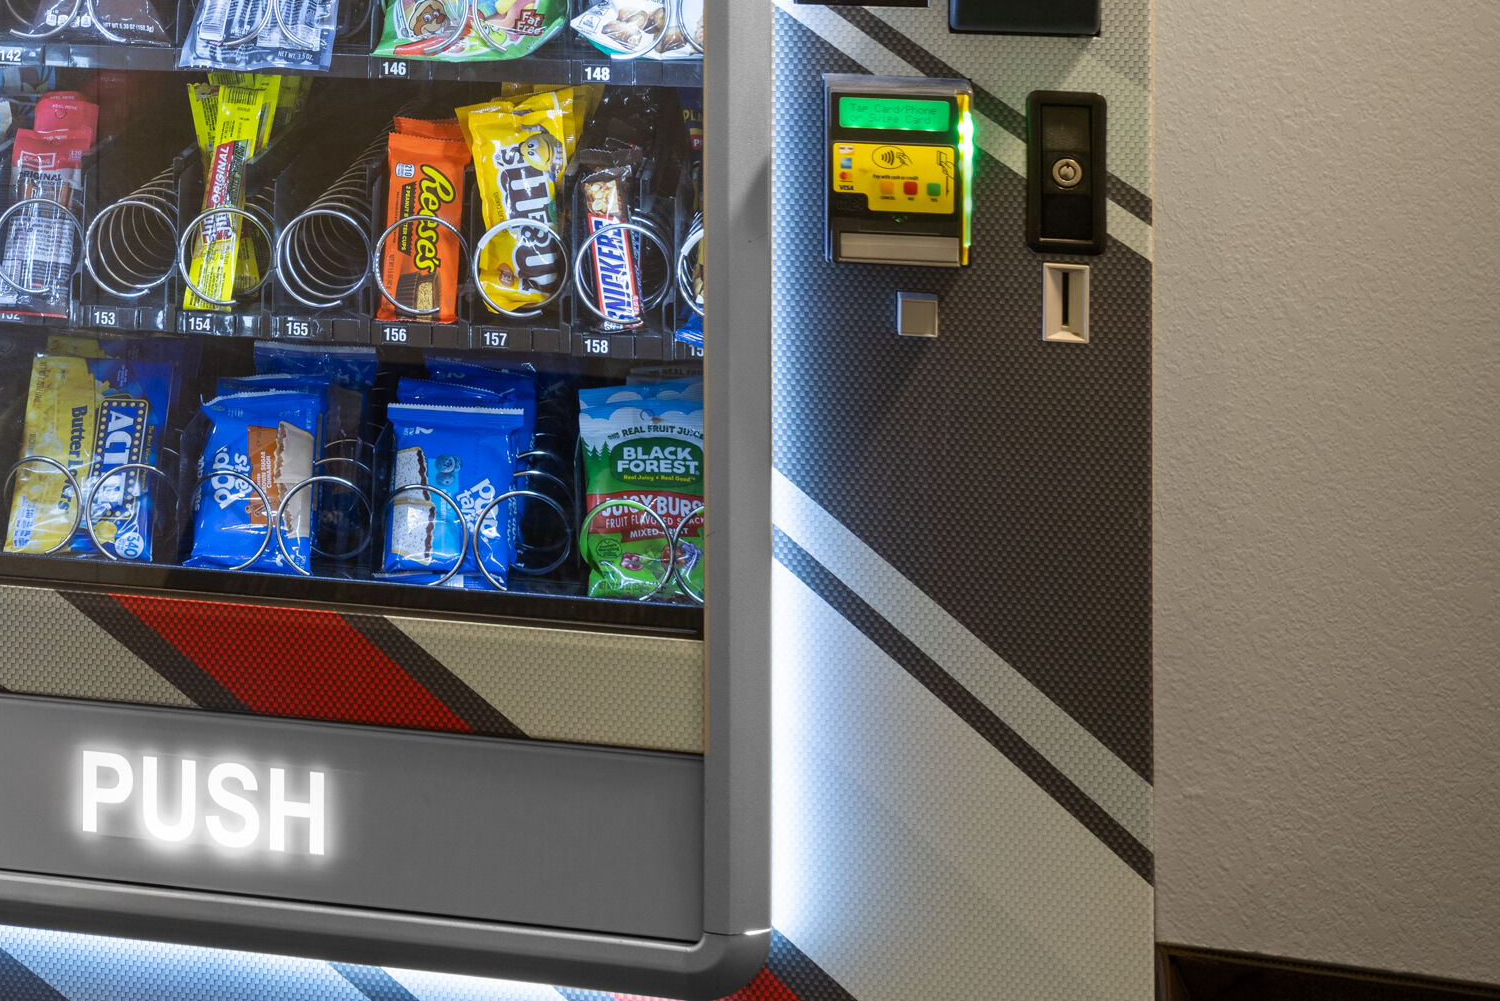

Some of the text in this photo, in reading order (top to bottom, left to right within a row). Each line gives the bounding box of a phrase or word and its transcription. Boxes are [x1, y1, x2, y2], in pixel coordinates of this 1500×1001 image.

[521, 12, 540, 26] Fat
[516, 22, 542, 34] Free
[0, 49, 21, 61] 142
[382, 62, 407, 76] 146
[585, 68, 610, 81] 148
[851, 103, 869, 113] Tap
[906, 115, 931, 125] Card
[212, 145, 230, 203] ORIGINAL
[404, 165, 413, 178] 210
[404, 190, 412, 214] PEANUT
[415, 164, 455, 273] Reese's
[94, 312, 116, 326] 153
[188, 318, 211, 331] 154
[286, 322, 308, 335] 155
[384, 328, 407, 342] 156
[484, 332, 507, 346] 157
[584, 340, 609, 354] 158
[69, 405, 88, 456] Butter
[622, 426, 646, 438] REAL
[648, 424, 676, 433] FRUIT
[104, 410, 135, 466] ACT
[623, 446, 693, 461] BLACK
[617, 460, 699, 475] FOREST
[602, 494, 654, 517] JUICY
[606, 517, 628, 529] FRUIT
[630, 528, 659, 539] MIXED
[126, 535, 139, 558] 340
[82, 750, 325, 856] PUSH
